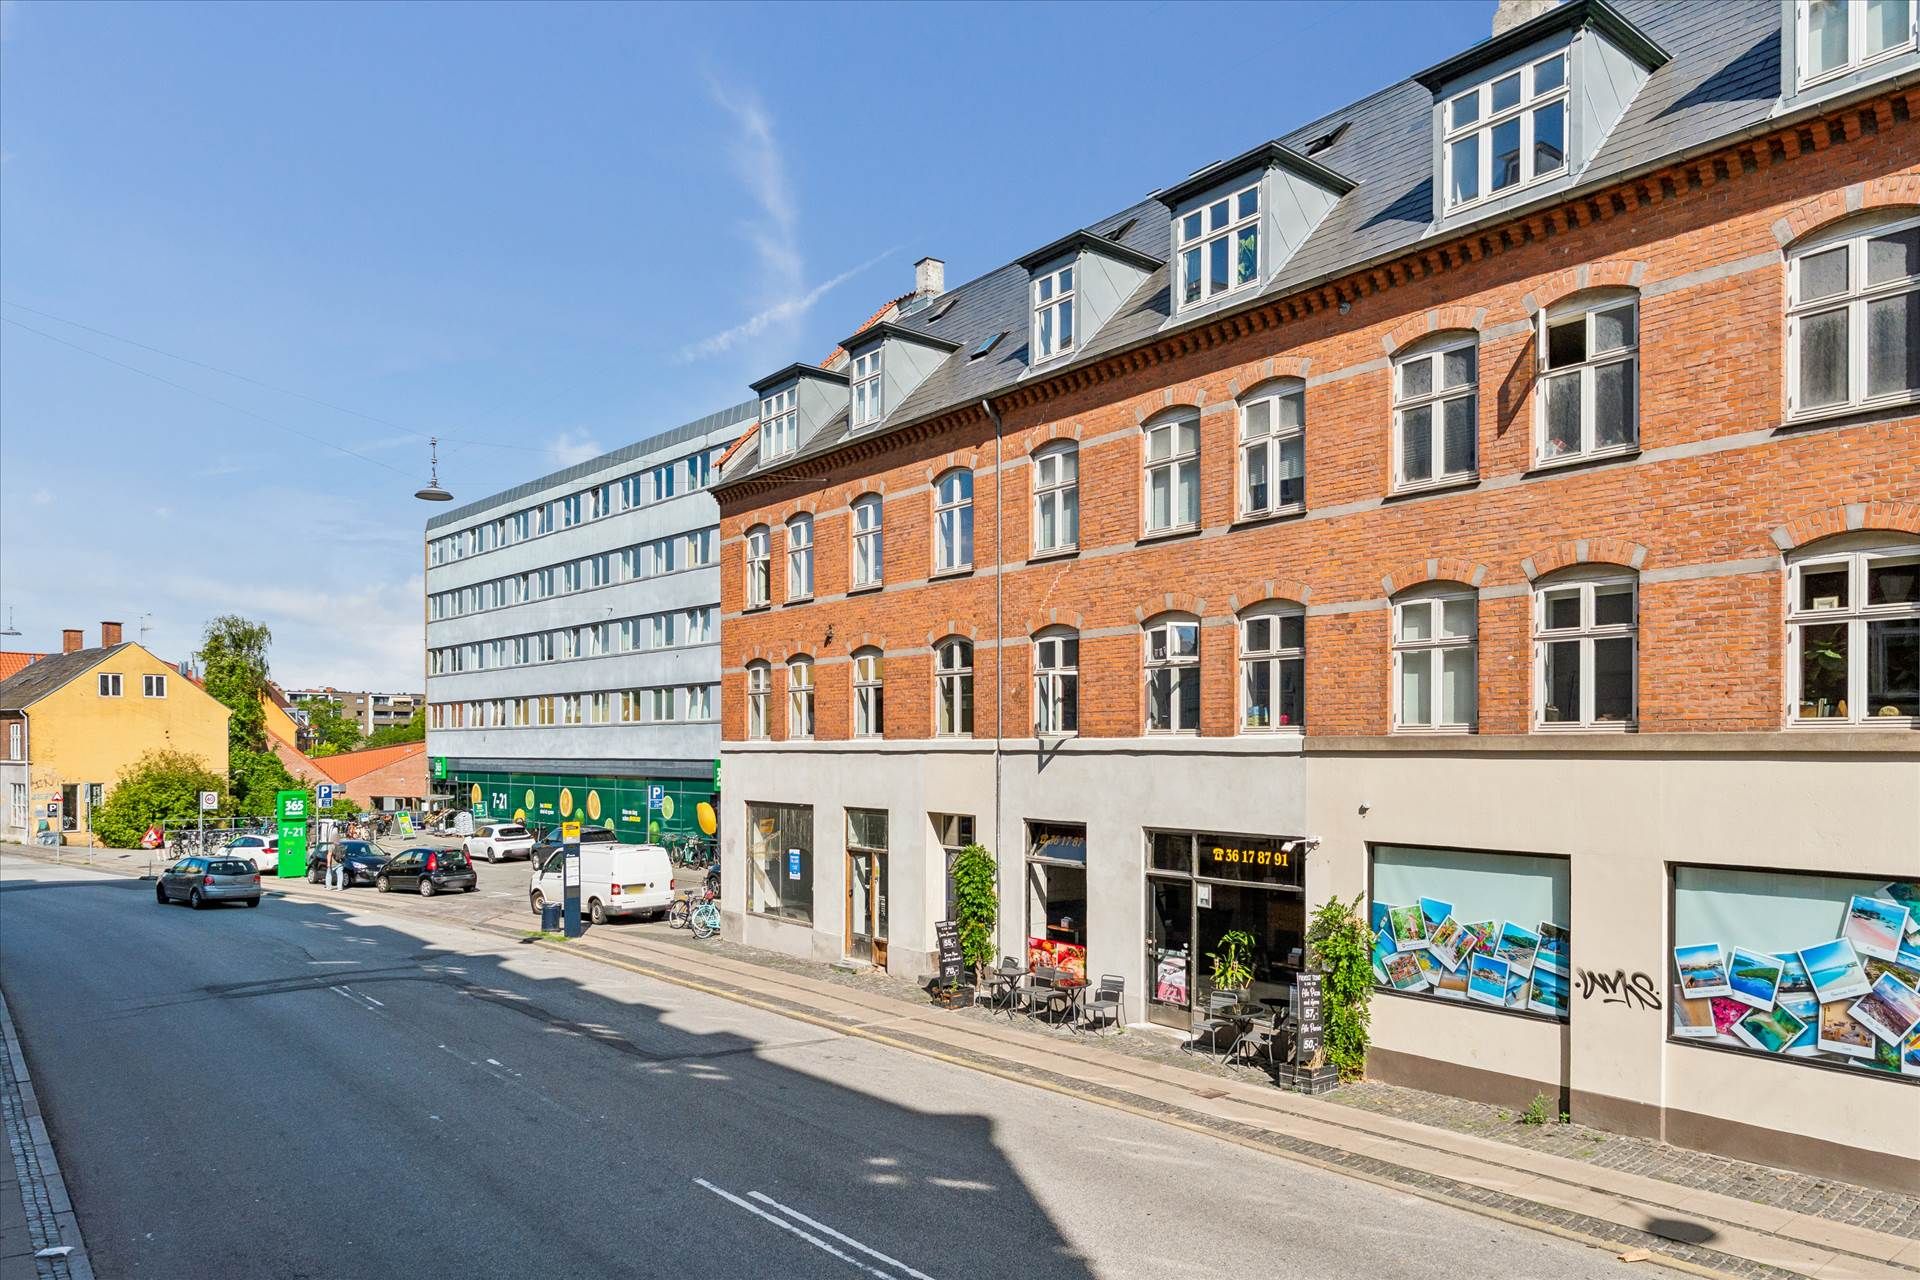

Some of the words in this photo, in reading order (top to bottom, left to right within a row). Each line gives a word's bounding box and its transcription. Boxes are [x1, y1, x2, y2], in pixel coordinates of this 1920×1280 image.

[321, 786, 330, 797] P
[653, 787, 661, 799] P
[285, 800, 304, 811] 365
[492, 793, 508, 809] 7-21
[49, 804, 57, 812] P
[282, 827, 304, 838] 7-21
[1225, 848, 1240, 863] 36
[1241, 850, 1256, 864] 17
[1257, 851, 1272, 865] 87
[1274, 852, 1289, 867] 91
